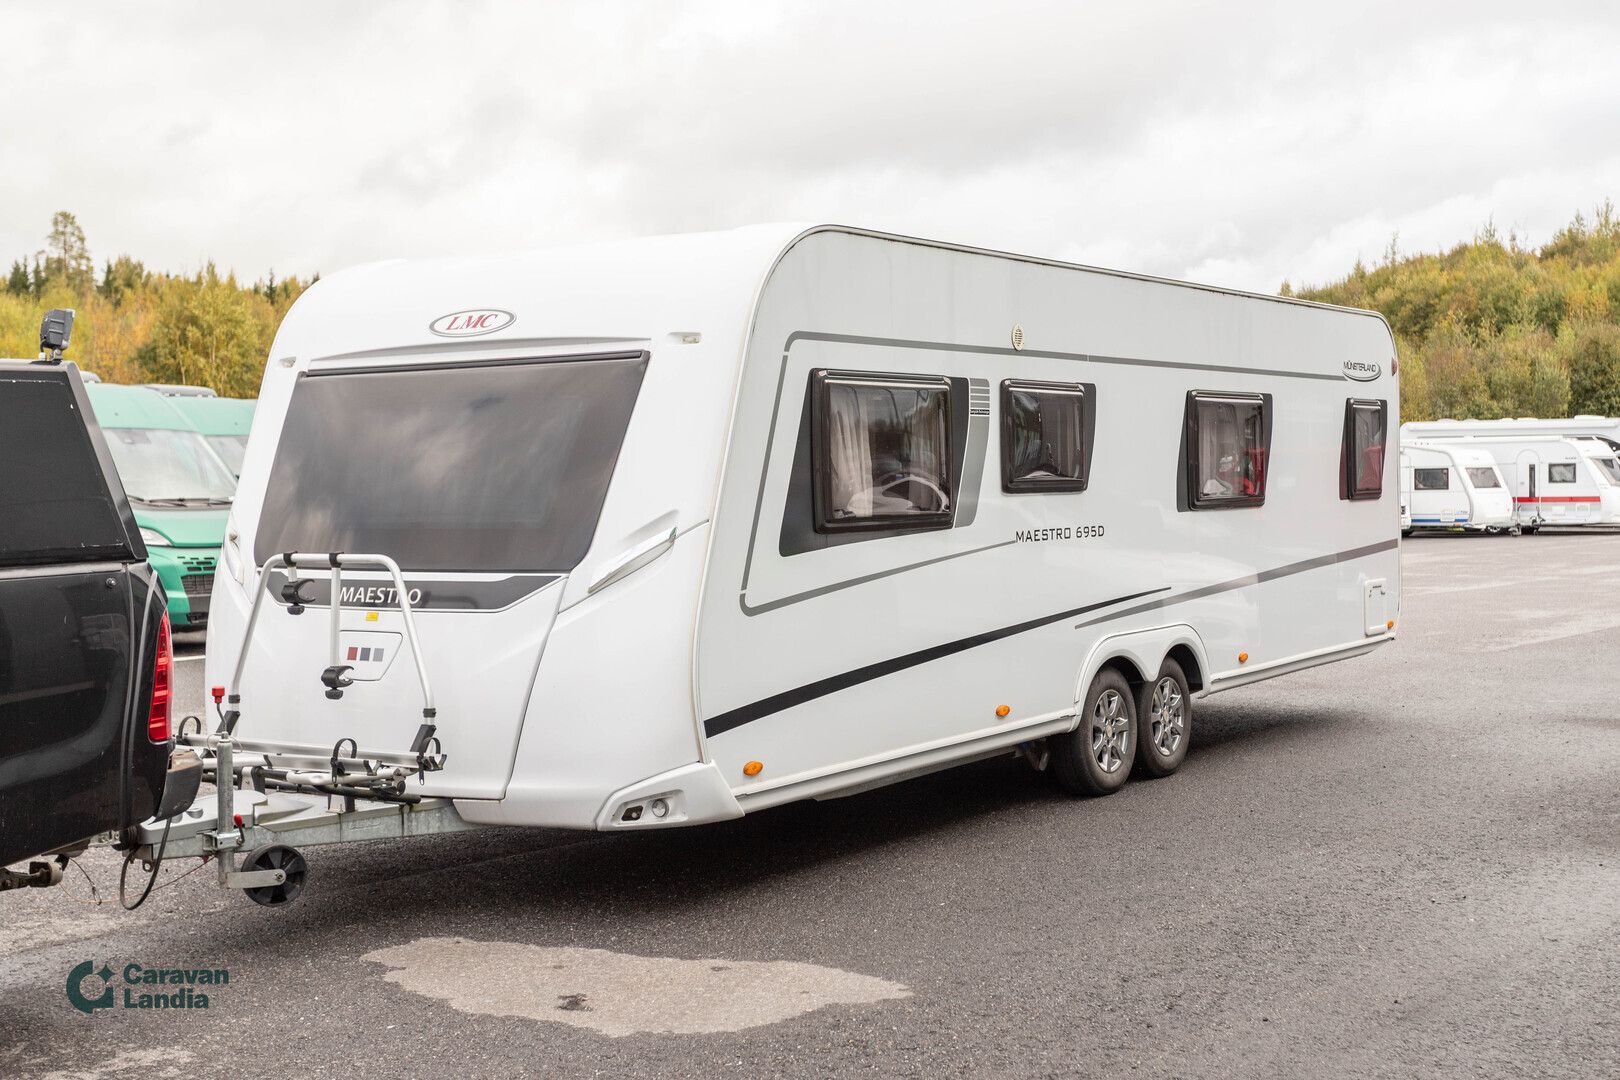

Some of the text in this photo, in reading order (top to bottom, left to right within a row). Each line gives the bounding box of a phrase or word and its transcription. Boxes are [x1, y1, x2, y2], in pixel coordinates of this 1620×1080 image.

[446, 313, 498, 330] LMC
[1015, 525, 1105, 542] MAESTRO 695D
